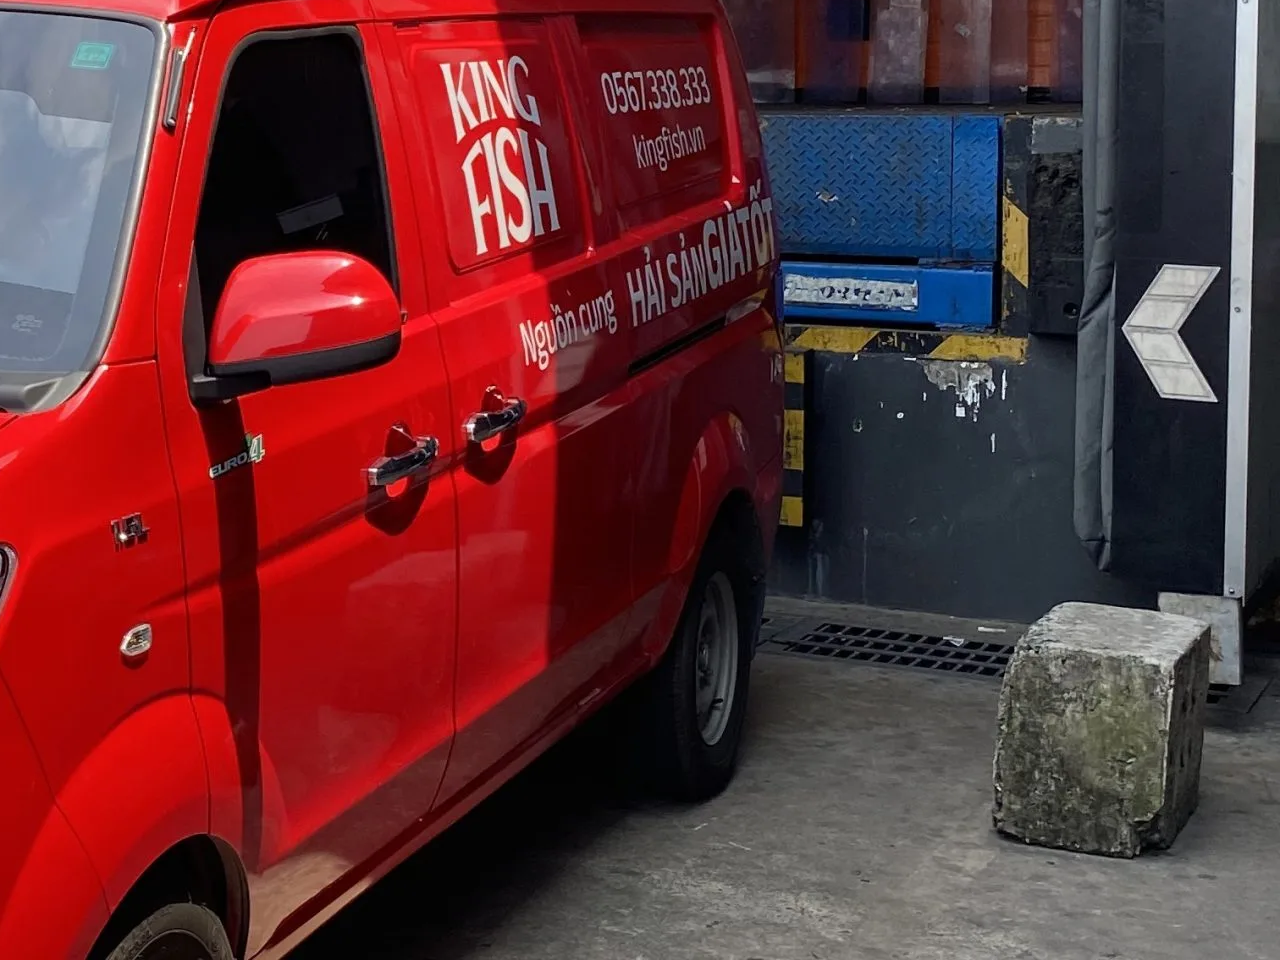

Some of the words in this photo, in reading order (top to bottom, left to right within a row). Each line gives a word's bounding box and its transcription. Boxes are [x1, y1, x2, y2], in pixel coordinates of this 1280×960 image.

[439, 55, 541, 144] KING
[600, 66, 711, 115] 0567.338.333
[461, 126, 561, 256] FISH
[632, 123, 707, 172] kingfish.vn
[519, 303, 578, 371] Nguồn
[578, 289, 618, 335] cung
[626, 246, 666, 327] HẢI
